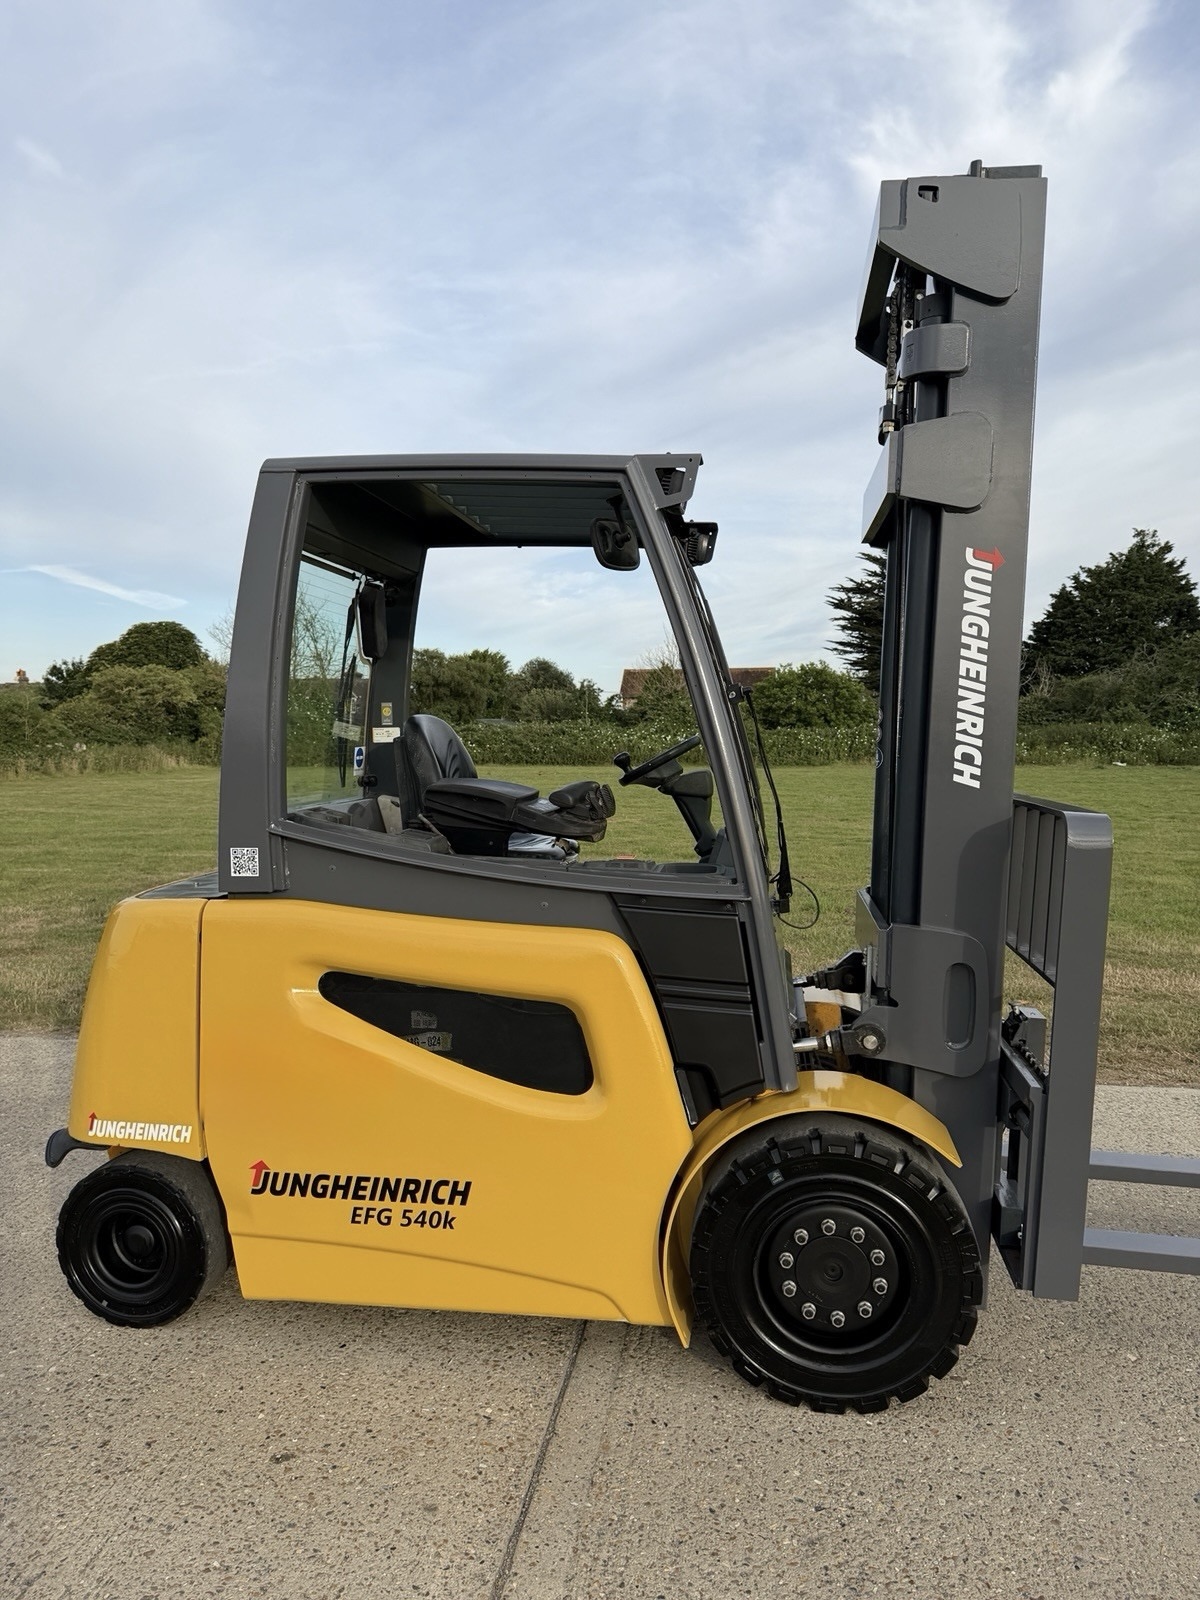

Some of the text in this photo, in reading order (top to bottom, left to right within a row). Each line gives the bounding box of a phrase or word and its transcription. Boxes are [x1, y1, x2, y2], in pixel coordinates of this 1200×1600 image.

[952, 546, 994, 789] JUNGHEINRICH
[88, 1118, 193, 1143] JUNGHEINRICH
[250, 1170, 473, 1206] JUNGHEINRICH
[350, 1206, 457, 1230] EFG 540k
